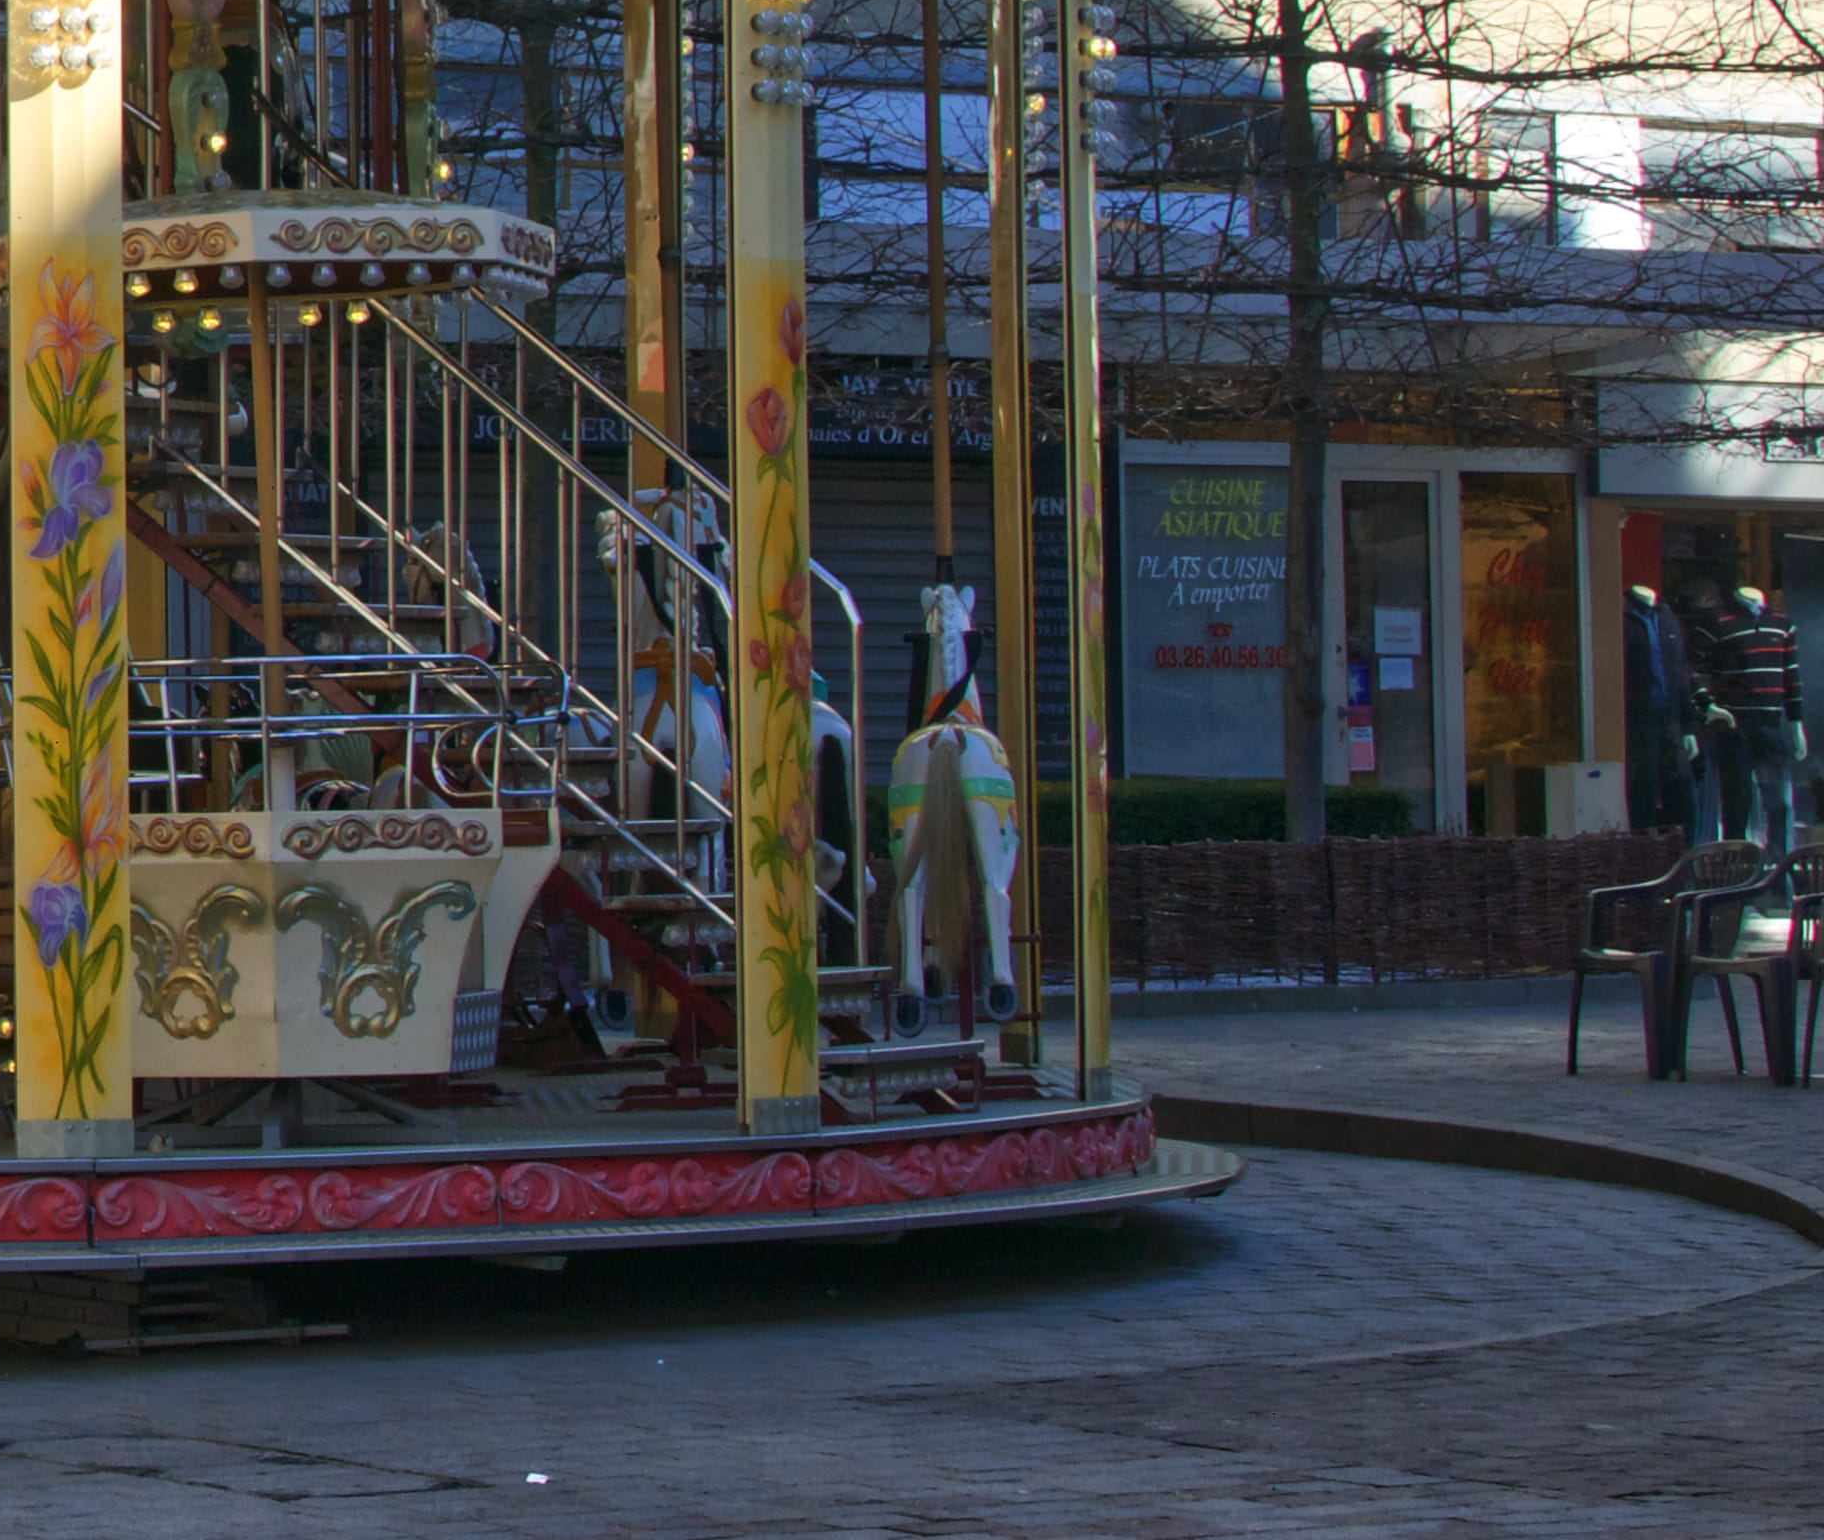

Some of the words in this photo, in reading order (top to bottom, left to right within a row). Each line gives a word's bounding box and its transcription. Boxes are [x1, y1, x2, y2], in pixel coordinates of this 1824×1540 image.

[1170, 479, 1266, 506] CUISINE
[1031, 497, 1066, 516] VEN
[1154, 510, 1284, 540] ASIATIQUE
[1137, 556, 1201, 579] PLATS
[1190, 582, 1274, 612] emporter
